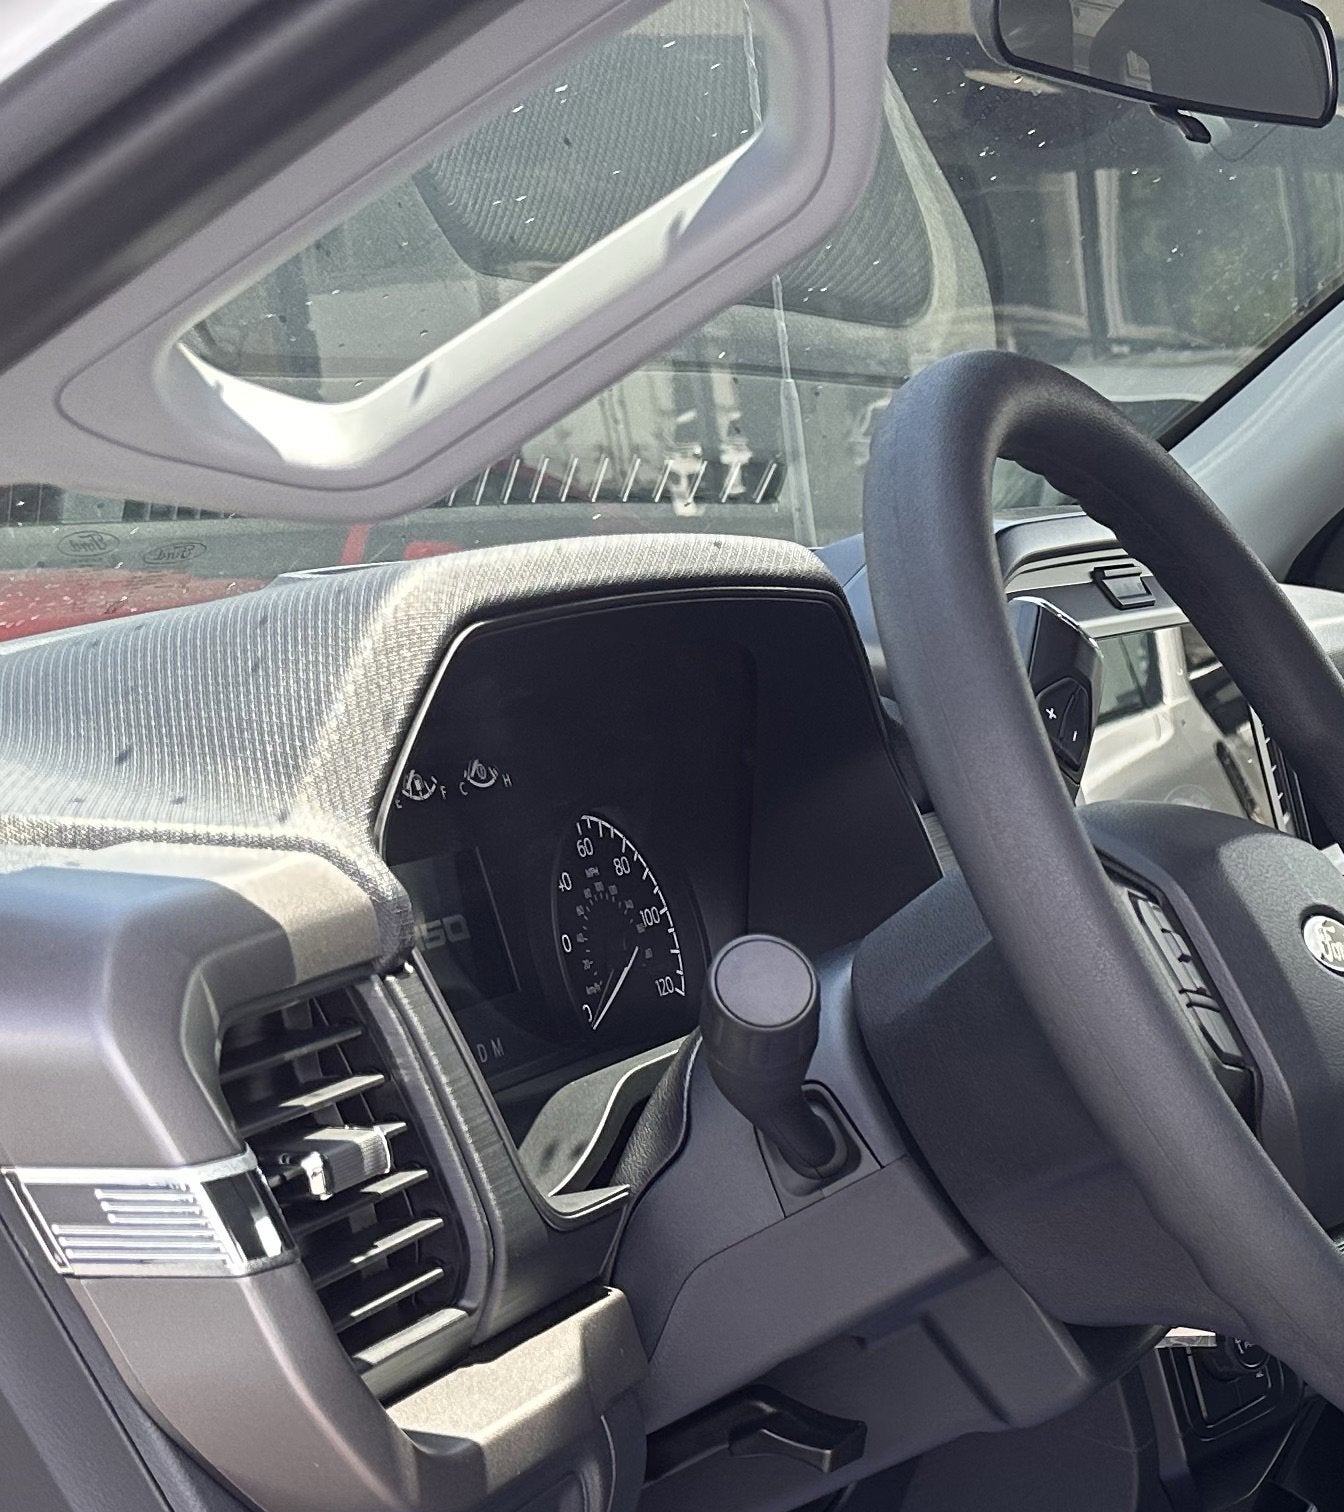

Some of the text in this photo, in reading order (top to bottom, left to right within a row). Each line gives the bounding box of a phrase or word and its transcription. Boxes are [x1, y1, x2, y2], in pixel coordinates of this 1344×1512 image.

[501, 773, 513, 788] H
[439, 785, 448, 799] F
[576, 837, 594, 858] 60
[612, 856, 631, 876] 80
[639, 906, 661, 928] 100
[654, 976, 675, 996] 120
